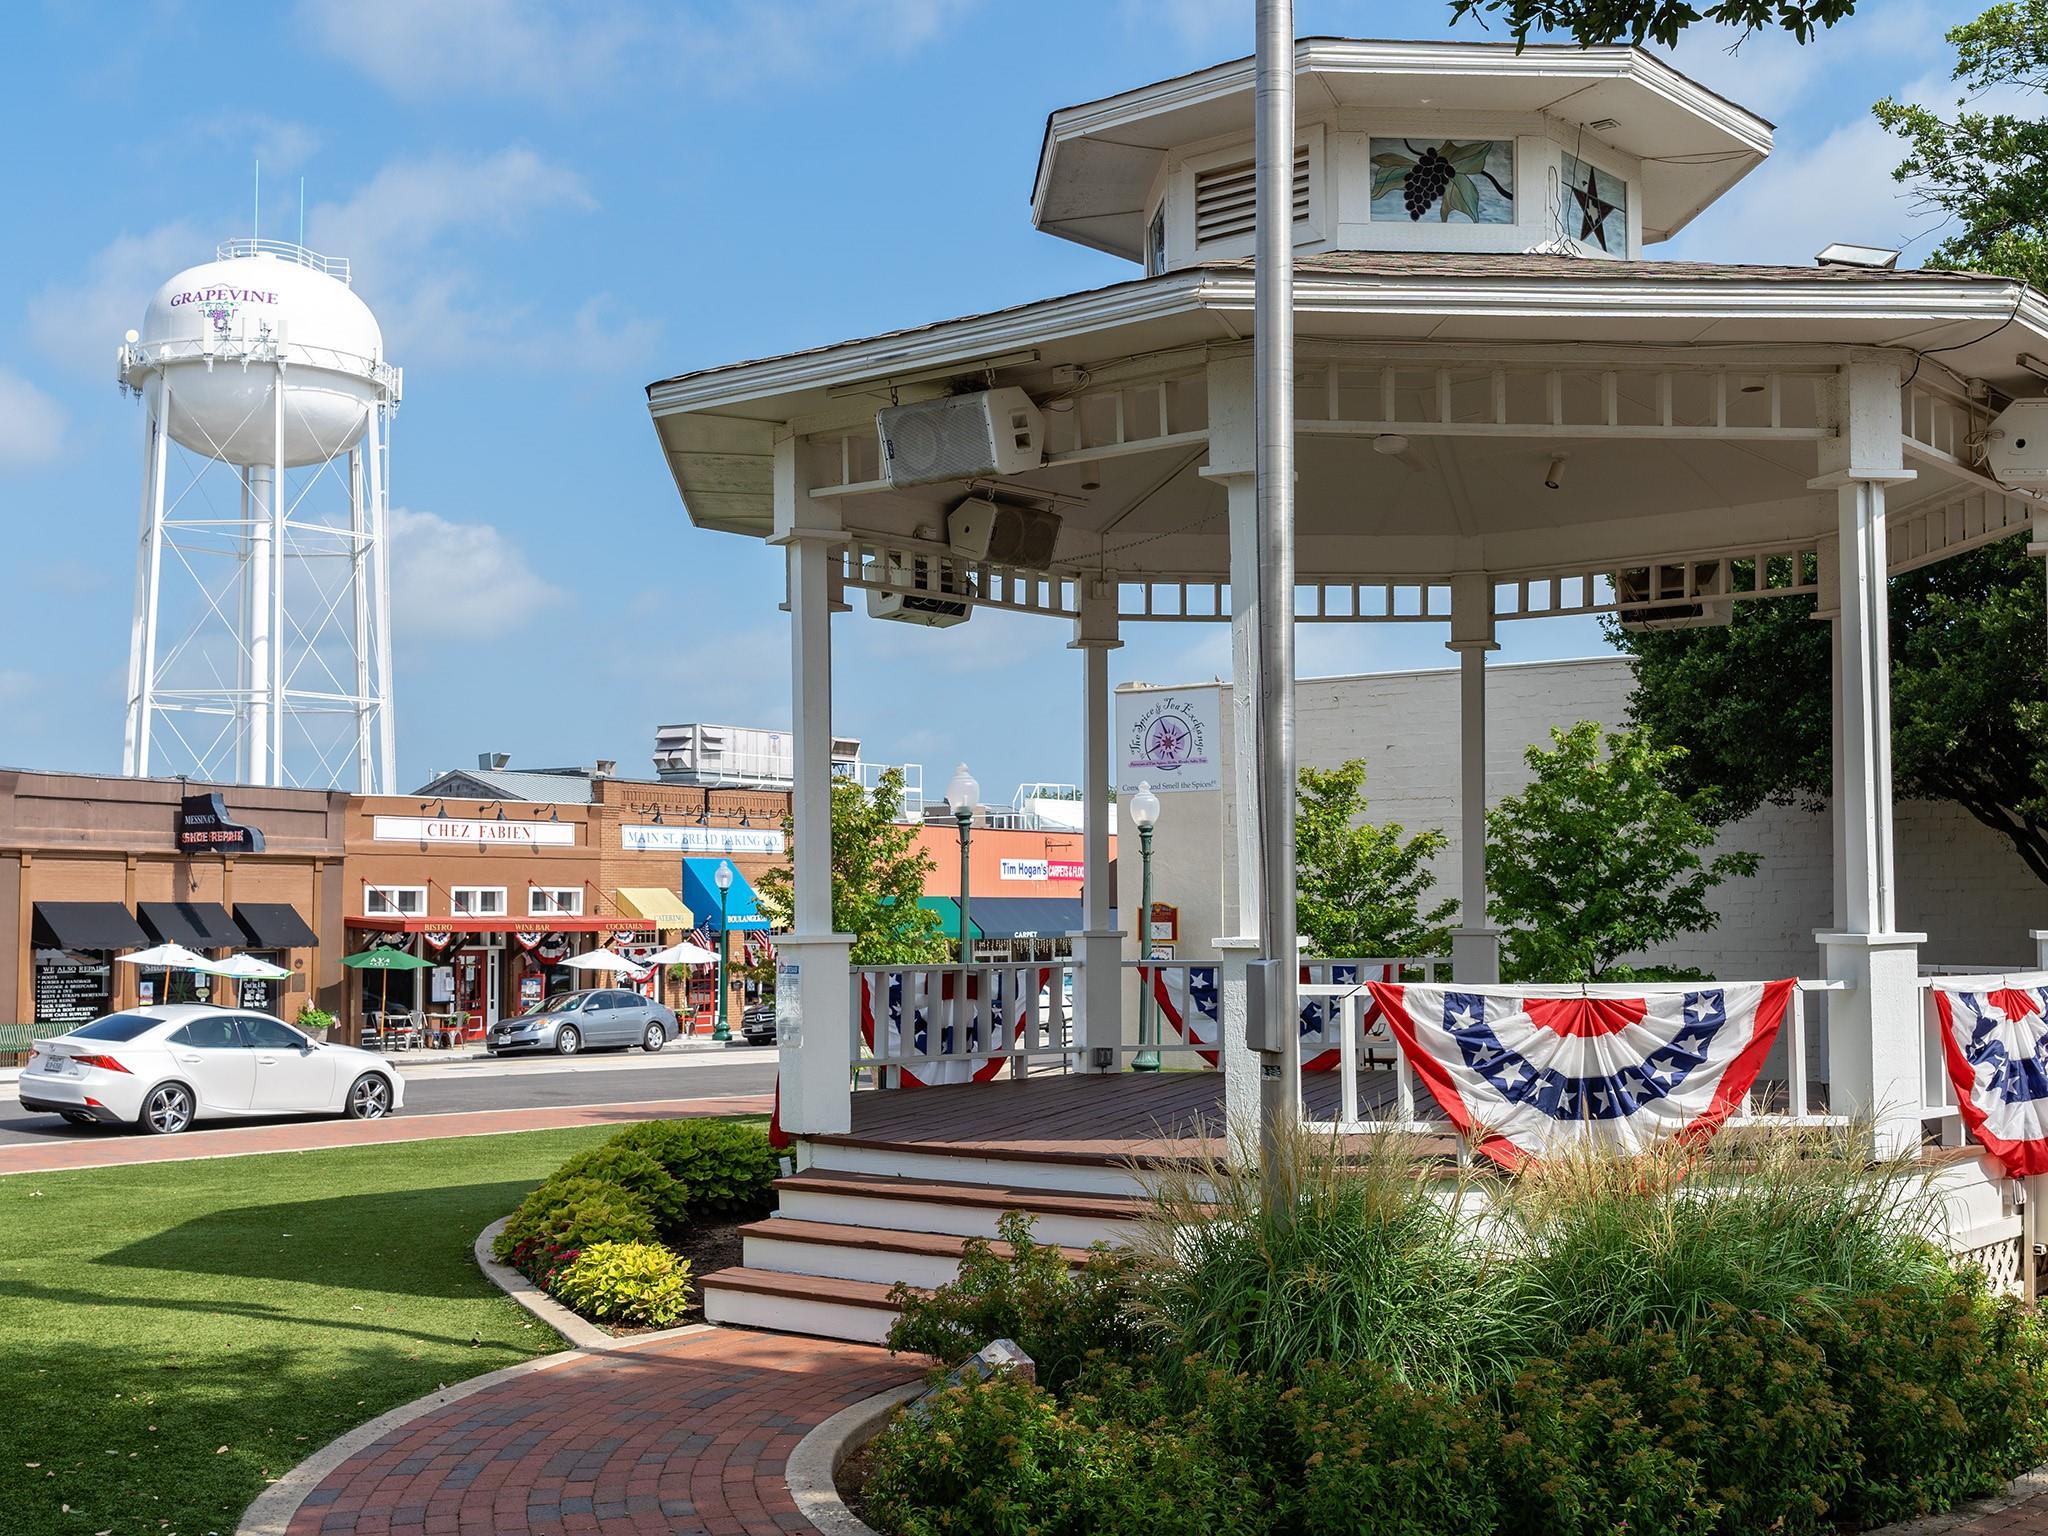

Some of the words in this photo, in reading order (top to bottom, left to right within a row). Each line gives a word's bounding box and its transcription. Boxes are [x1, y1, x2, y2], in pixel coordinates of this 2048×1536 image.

[170, 290, 278, 306] GRAPEVINE
[1129, 734, 1141, 755] The
[1155, 703, 1162, 714] &
[1164, 697, 1180, 710] Tea
[1162, 781, 1179, 790] Smell
[1180, 781, 1191, 789] the
[184, 814, 216, 824] MESSINA'S
[182, 832, 208, 843] SHOE
[209, 830, 244, 842] REPAIR
[427, 823, 470, 838] CHEZ
[479, 825, 531, 840] FABIEN
[628, 831, 658, 844] MAIN
[662, 832, 678, 844] ST.
[682, 833, 718, 846] BREAD
[721, 834, 760, 846] BAKING
[764, 836, 780, 846] CO.
[1002, 862, 1016, 875] Tim
[1018, 862, 1047, 878] Hogan's
[1048, 865, 1068, 877] CARPETS
[424, 923, 453, 931] BISTRO
